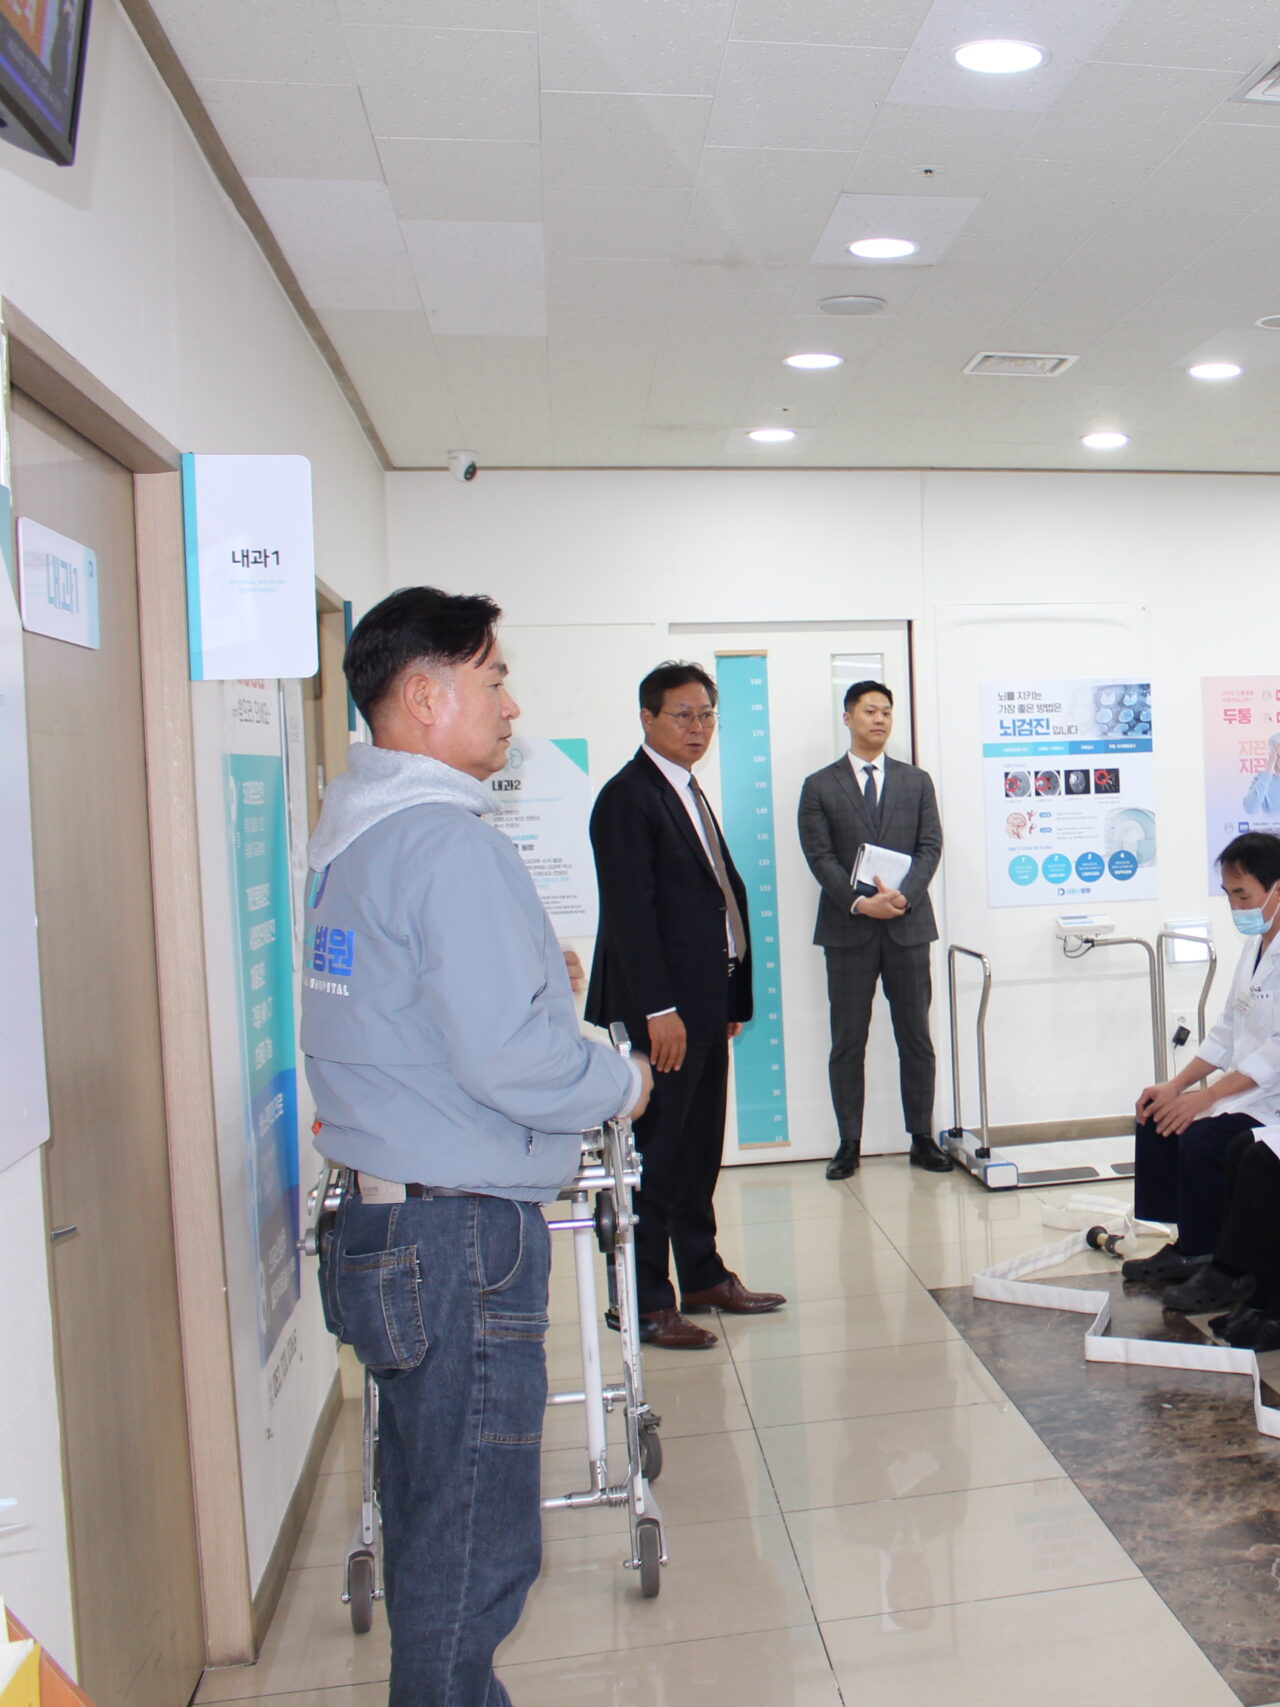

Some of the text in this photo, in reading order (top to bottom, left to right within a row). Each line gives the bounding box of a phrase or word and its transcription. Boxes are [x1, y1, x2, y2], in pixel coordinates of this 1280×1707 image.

[232, 549, 280, 568] 내과1
[1223, 708, 1252, 725] 두통
[999, 718, 1079, 736] 뇌검진 입니다
[1239, 740, 1267, 756] 지끈
[492, 779, 521, 792] 내과2
